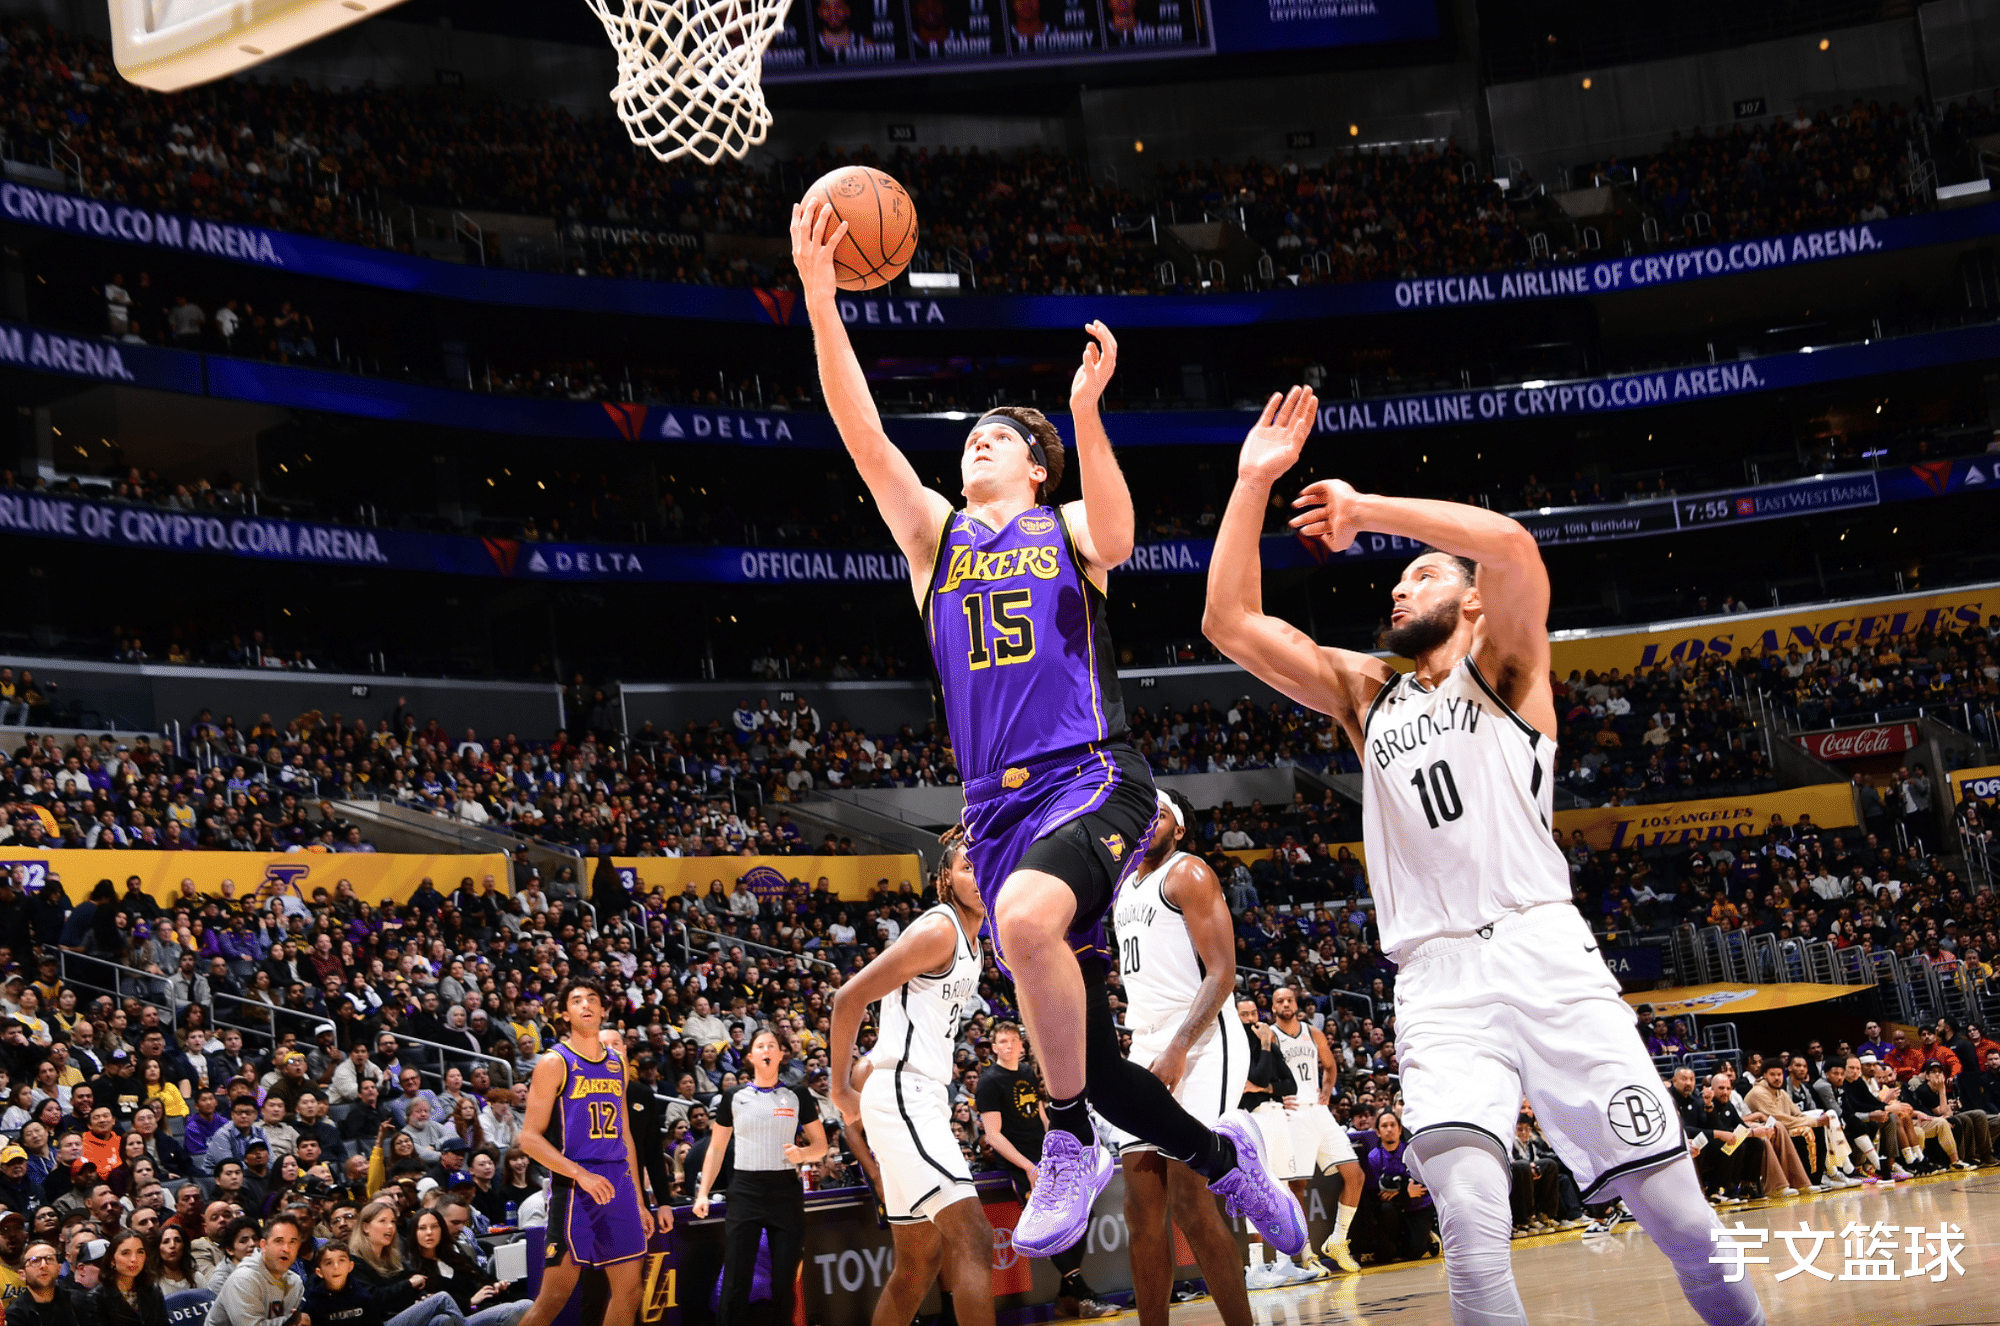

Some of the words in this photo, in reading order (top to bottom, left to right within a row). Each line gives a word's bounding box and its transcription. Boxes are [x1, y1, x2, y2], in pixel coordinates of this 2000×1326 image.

[1740, 101, 1760, 115] 307
[1, 183, 184, 249] CRYPTO.COM
[187, 219, 284, 266] ARENA.
[1394, 276, 1496, 308] OFFICIAL
[1500, 266, 1590, 300] AIRLINE
[1593, 263, 1624, 290] OF
[1628, 237, 1786, 285] CRYPTO.COM
[1791, 225, 1884, 260] ARENA.
[840, 300, 945, 324] DELTA
[30, 332, 136, 381] ARENA.
[1316, 402, 1377, 433] ICIAL
[1382, 392, 1474, 427] AIRLINE
[1478, 390, 1508, 418] OF
[1514, 375, 1668, 416] CRYPTO.COM
[1673, 363, 1766, 398] ARENA.
[692, 413, 794, 441] DELTA
[1564, 522, 1588, 535] 10th
[1591, 518, 1641, 532] Birthday
[1685, 500, 1728, 522] 7:55
[79, 504, 116, 539] OF
[120, 507, 294, 556] CRYPTO.COM
[299, 527, 388, 563] ARENA.
[1371, 534, 1421, 553] DEL
[555, 550, 643, 573] DELTA
[741, 550, 840, 580] OFFICIAL
[843, 552, 911, 580] AIRLIN
[937, 544, 1061, 594] LAKERS
[962, 588, 1036, 671] 15
[1640, 634, 1734, 668] LOS
[1749, 602, 1982, 652] ANGELES
[1819, 727, 1891, 758] Coca-Cola
[1410, 760, 1463, 829] 10
[1641, 816, 1672, 828] LOS
[1674, 808, 1753, 825] ANGELES
[1124, 936, 1140, 975] 20
[569, 1075, 622, 1099] LAKERS
[1297, 1062, 1311, 1081] 12
[588, 1101, 618, 1139] 12
[1625, 1095, 1651, 1137] B
[814, 1246, 892, 1294] TOY
